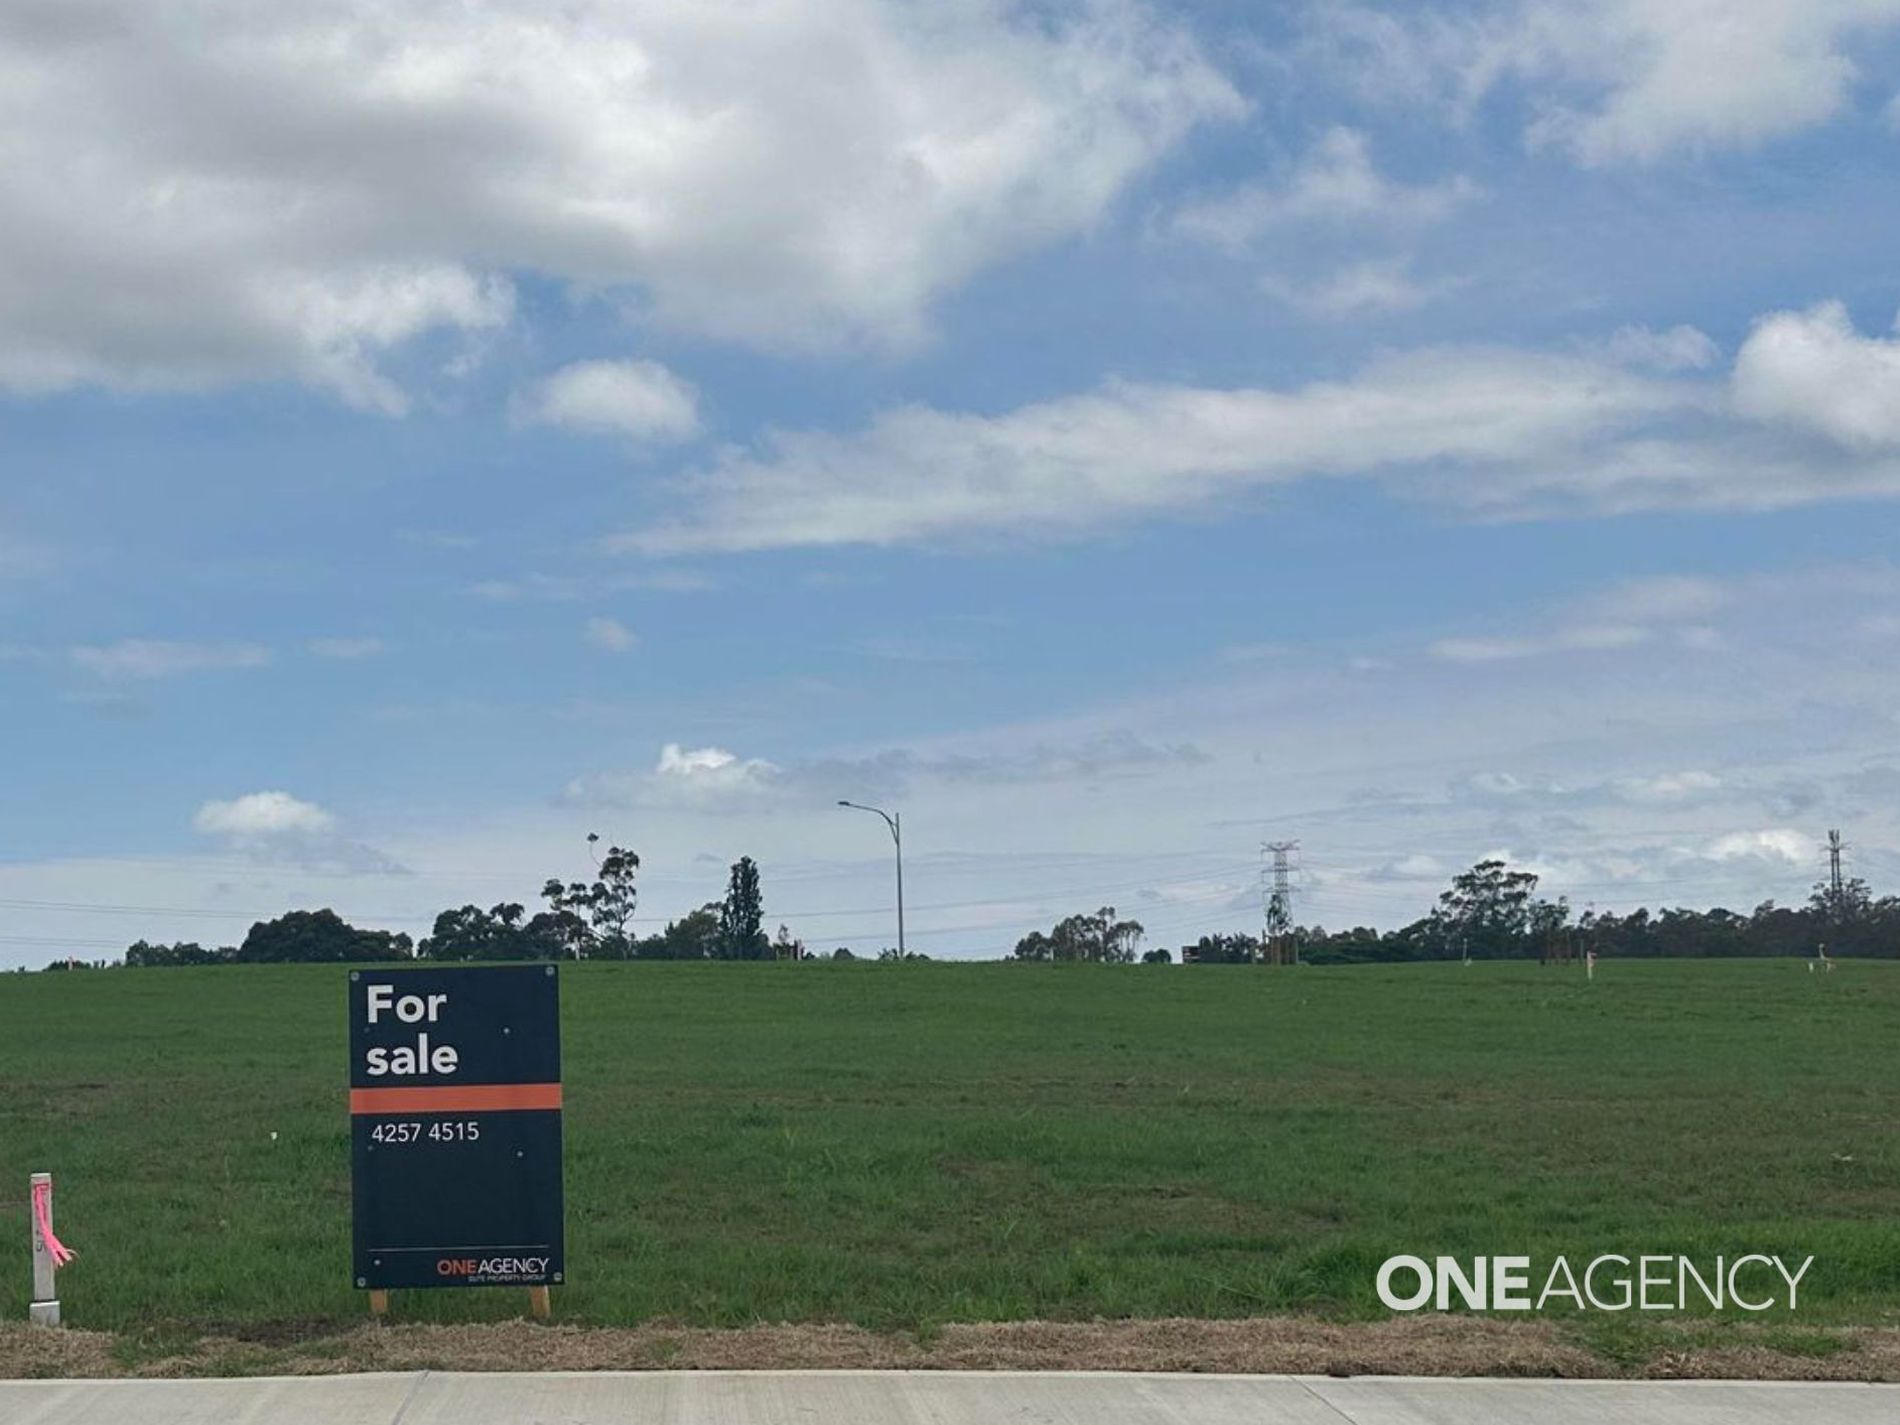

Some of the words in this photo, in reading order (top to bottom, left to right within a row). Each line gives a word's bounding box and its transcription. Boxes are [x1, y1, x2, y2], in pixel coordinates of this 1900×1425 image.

[366, 984, 448, 1024] For
[366, 1033, 459, 1075] sale
[371, 1123, 421, 1143] 4257
[428, 1122, 480, 1142] 4515
